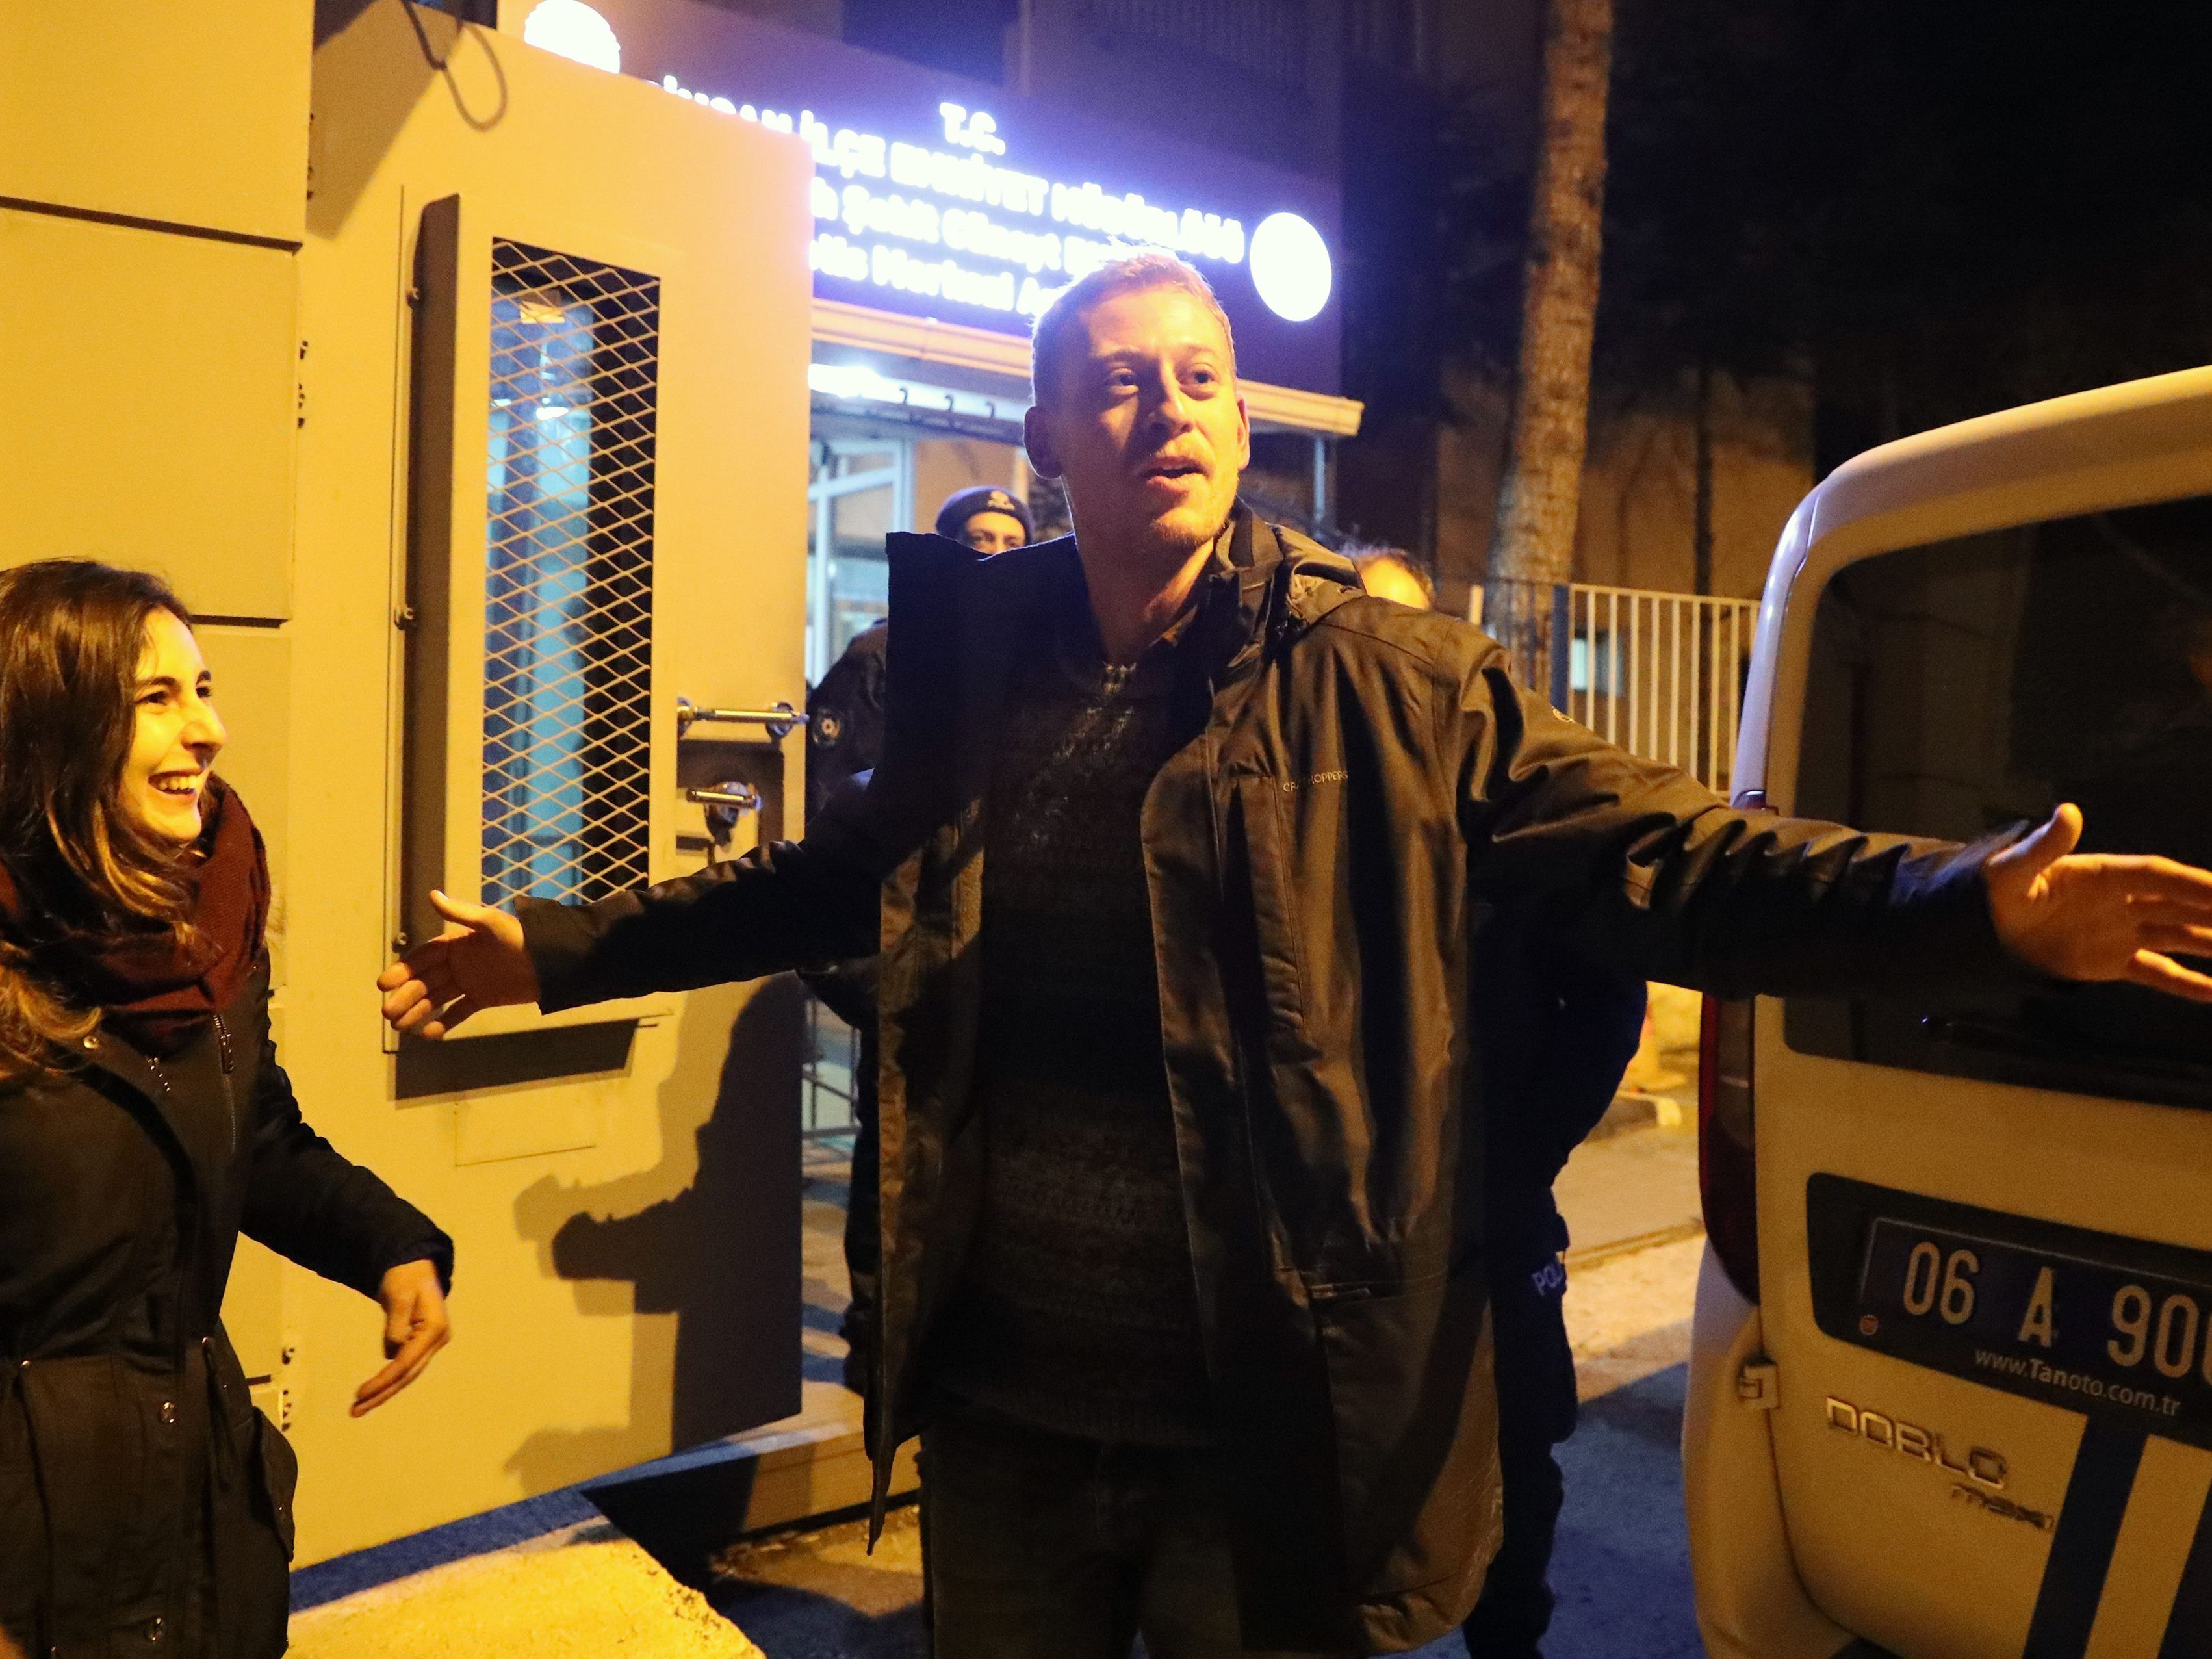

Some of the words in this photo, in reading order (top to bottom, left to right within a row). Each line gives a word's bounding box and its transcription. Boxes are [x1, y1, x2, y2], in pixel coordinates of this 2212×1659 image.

[940, 101, 1006, 155] T.C.
[1901, 1241, 1981, 1326] 06
[2018, 1265, 2057, 1349] A
[2106, 1283, 2212, 1387] 90
[1974, 1348, 2183, 1418] www.Tanoto.com.tr
[1825, 1396, 2011, 1491] DOBLO
